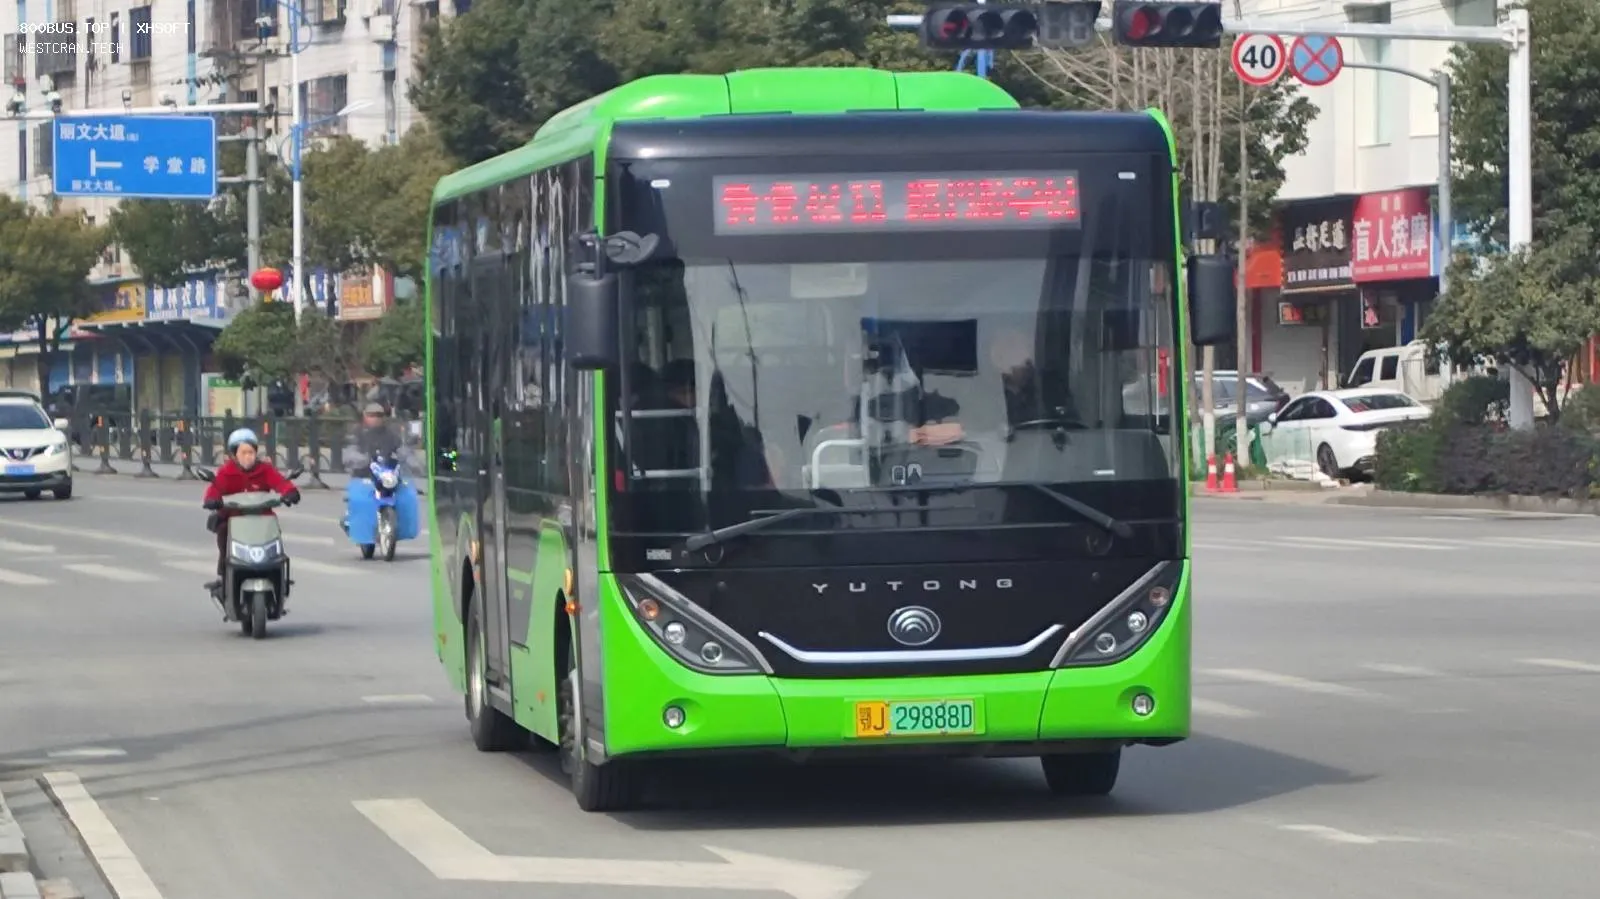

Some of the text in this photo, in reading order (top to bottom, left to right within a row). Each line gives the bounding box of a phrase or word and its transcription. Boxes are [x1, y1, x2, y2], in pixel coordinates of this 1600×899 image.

[1241, 44, 1277, 70] 40
[143, 155, 207, 175] 学堂路
[1353, 212, 1428, 262] 盲人按摩
[811, 577, 1013, 594] YUTONG
[894, 703, 973, 731] 29888D
